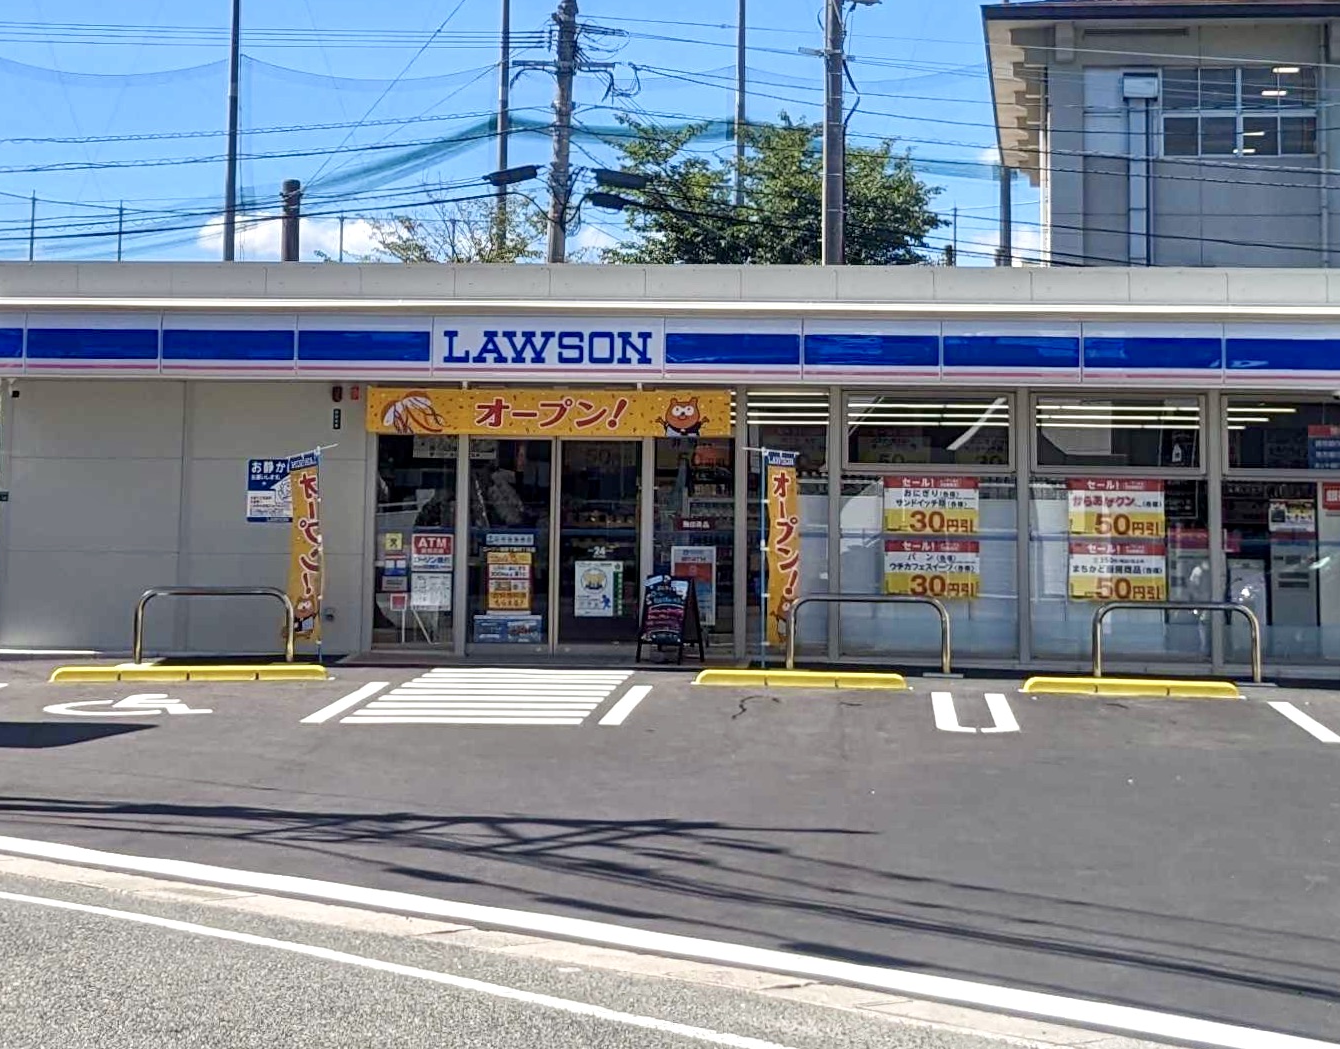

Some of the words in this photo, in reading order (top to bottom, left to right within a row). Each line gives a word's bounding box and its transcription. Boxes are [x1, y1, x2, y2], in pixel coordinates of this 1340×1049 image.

[443, 330, 652, 364] LAWSON
[476, 398, 628, 429] オープン!
[251, 460, 290, 473] お静か
[902, 478, 935, 488] セール!
[1087, 480, 1120, 490] セール!
[909, 510, 974, 533] 30円引
[1095, 513, 1160, 536] 50円引
[418, 537, 448, 548] ATM
[773, 472, 800, 596] オープン!
[902, 541, 935, 552] セール!
[1087, 544, 1121, 554] セール!
[910, 574, 975, 598] 30円引
[1096, 578, 1161, 600] 50円引
